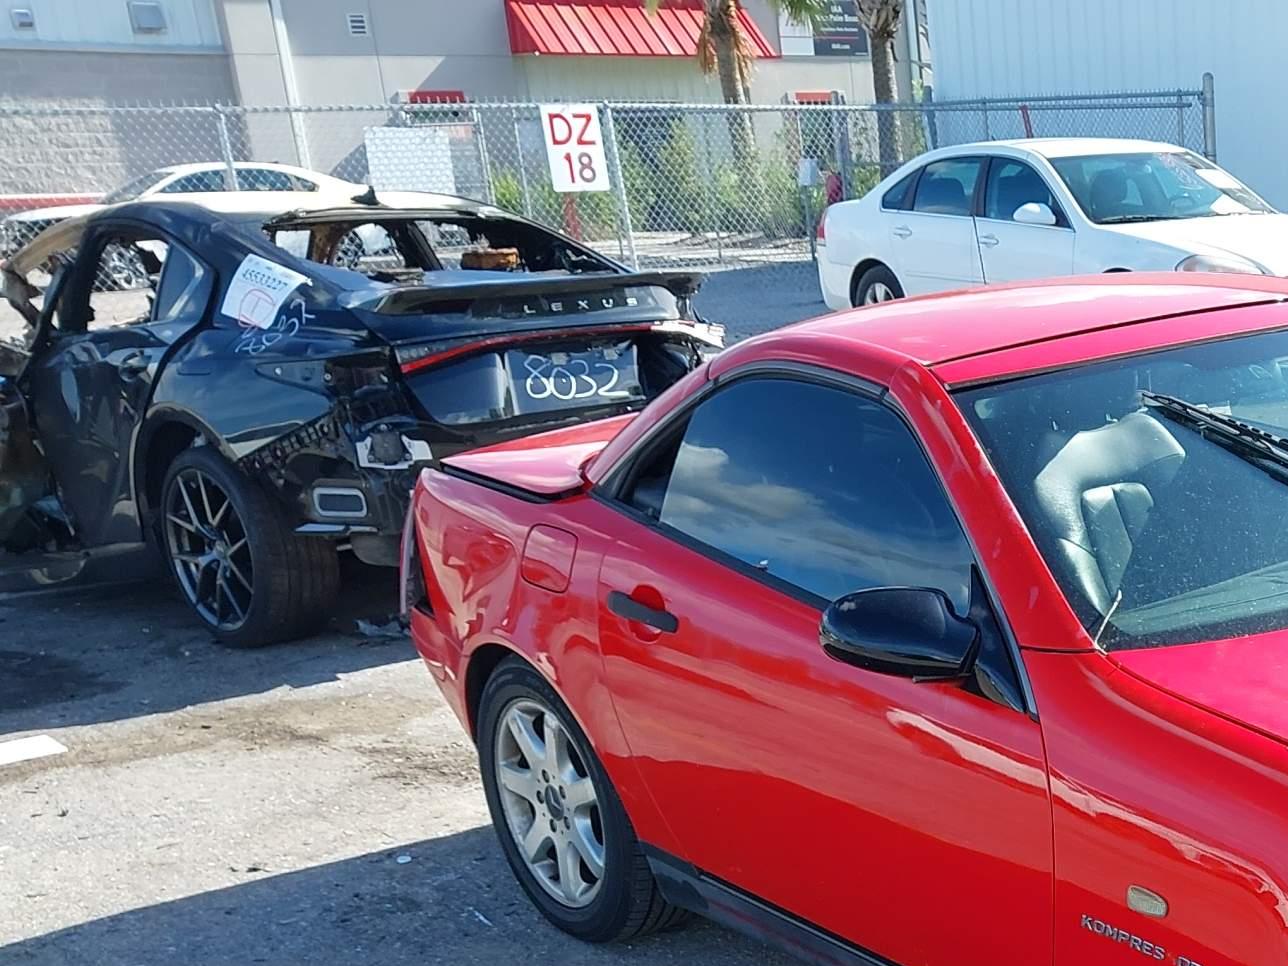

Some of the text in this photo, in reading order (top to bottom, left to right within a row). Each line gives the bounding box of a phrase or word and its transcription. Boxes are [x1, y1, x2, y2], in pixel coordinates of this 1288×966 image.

[548, 113, 597, 145] DZ
[564, 152, 597, 184] 18
[523, 297, 638, 314] LEXUS
[524, 354, 630, 399] 8032
